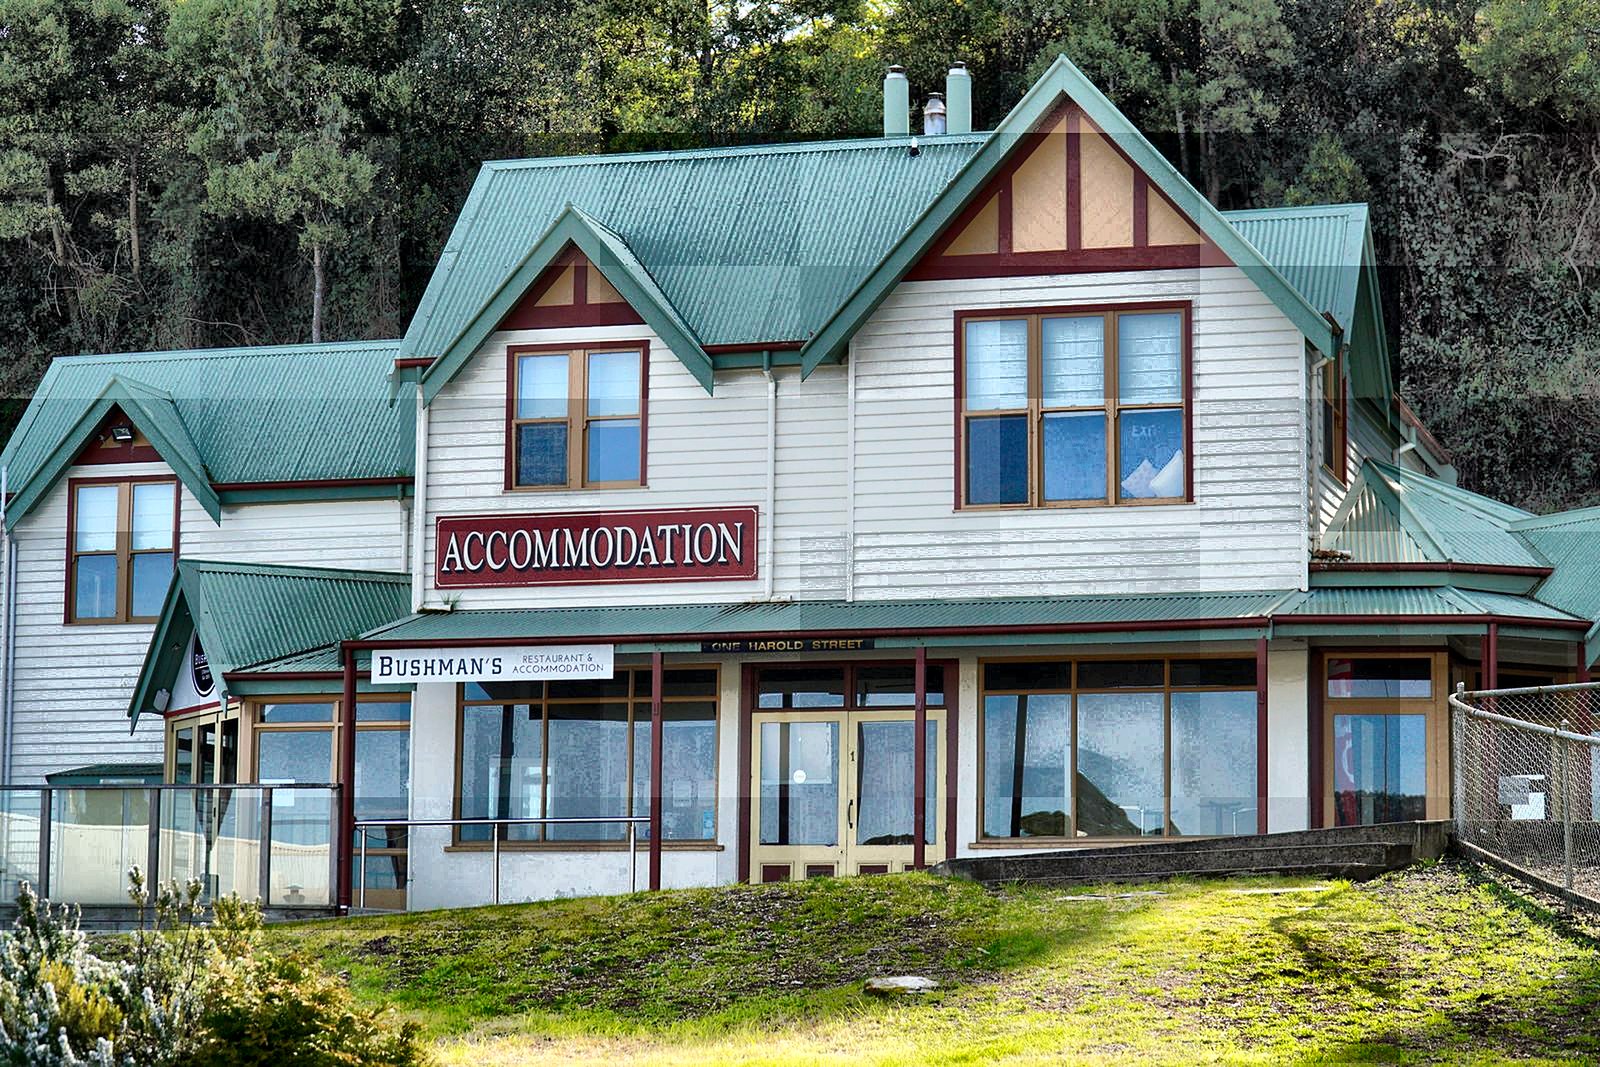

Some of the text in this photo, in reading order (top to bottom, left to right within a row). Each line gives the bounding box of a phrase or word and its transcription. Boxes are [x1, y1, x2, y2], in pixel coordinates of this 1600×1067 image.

[441, 522, 745, 573] ACCOMMODATION
[711, 639, 864, 651] ONE HAROLD STREET
[522, 652, 593, 664] RESTAURANT &
[379, 656, 503, 677] BUSHMAN'S
[512, 663, 604, 674] ACCOMMODATION
[850, 751, 855, 762] 1
